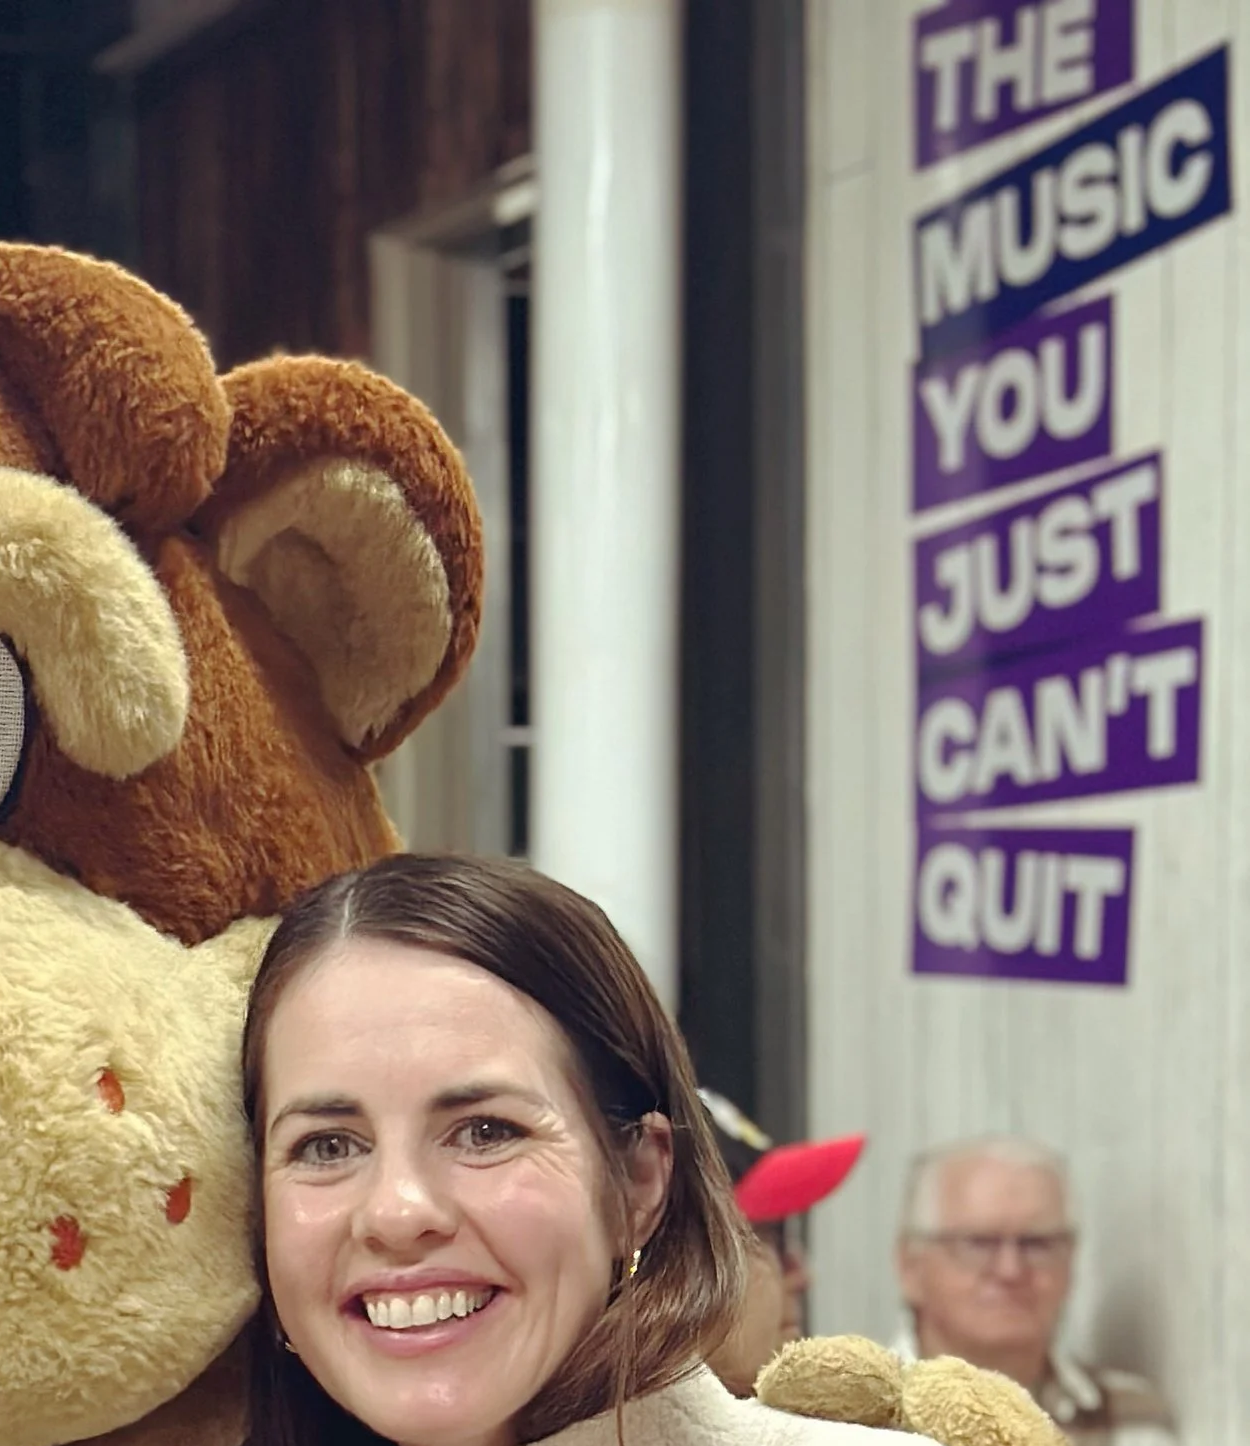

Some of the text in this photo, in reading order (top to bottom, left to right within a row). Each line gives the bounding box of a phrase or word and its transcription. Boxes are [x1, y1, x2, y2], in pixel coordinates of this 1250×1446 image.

[921, 0, 1095, 131] THE
[919, 98, 1213, 326] MUSIC
[919, 322, 1107, 474] YOU
[919, 463, 1158, 656] JUST
[918, 645, 1198, 804] CAN'T
[917, 841, 1128, 962] QUIT
